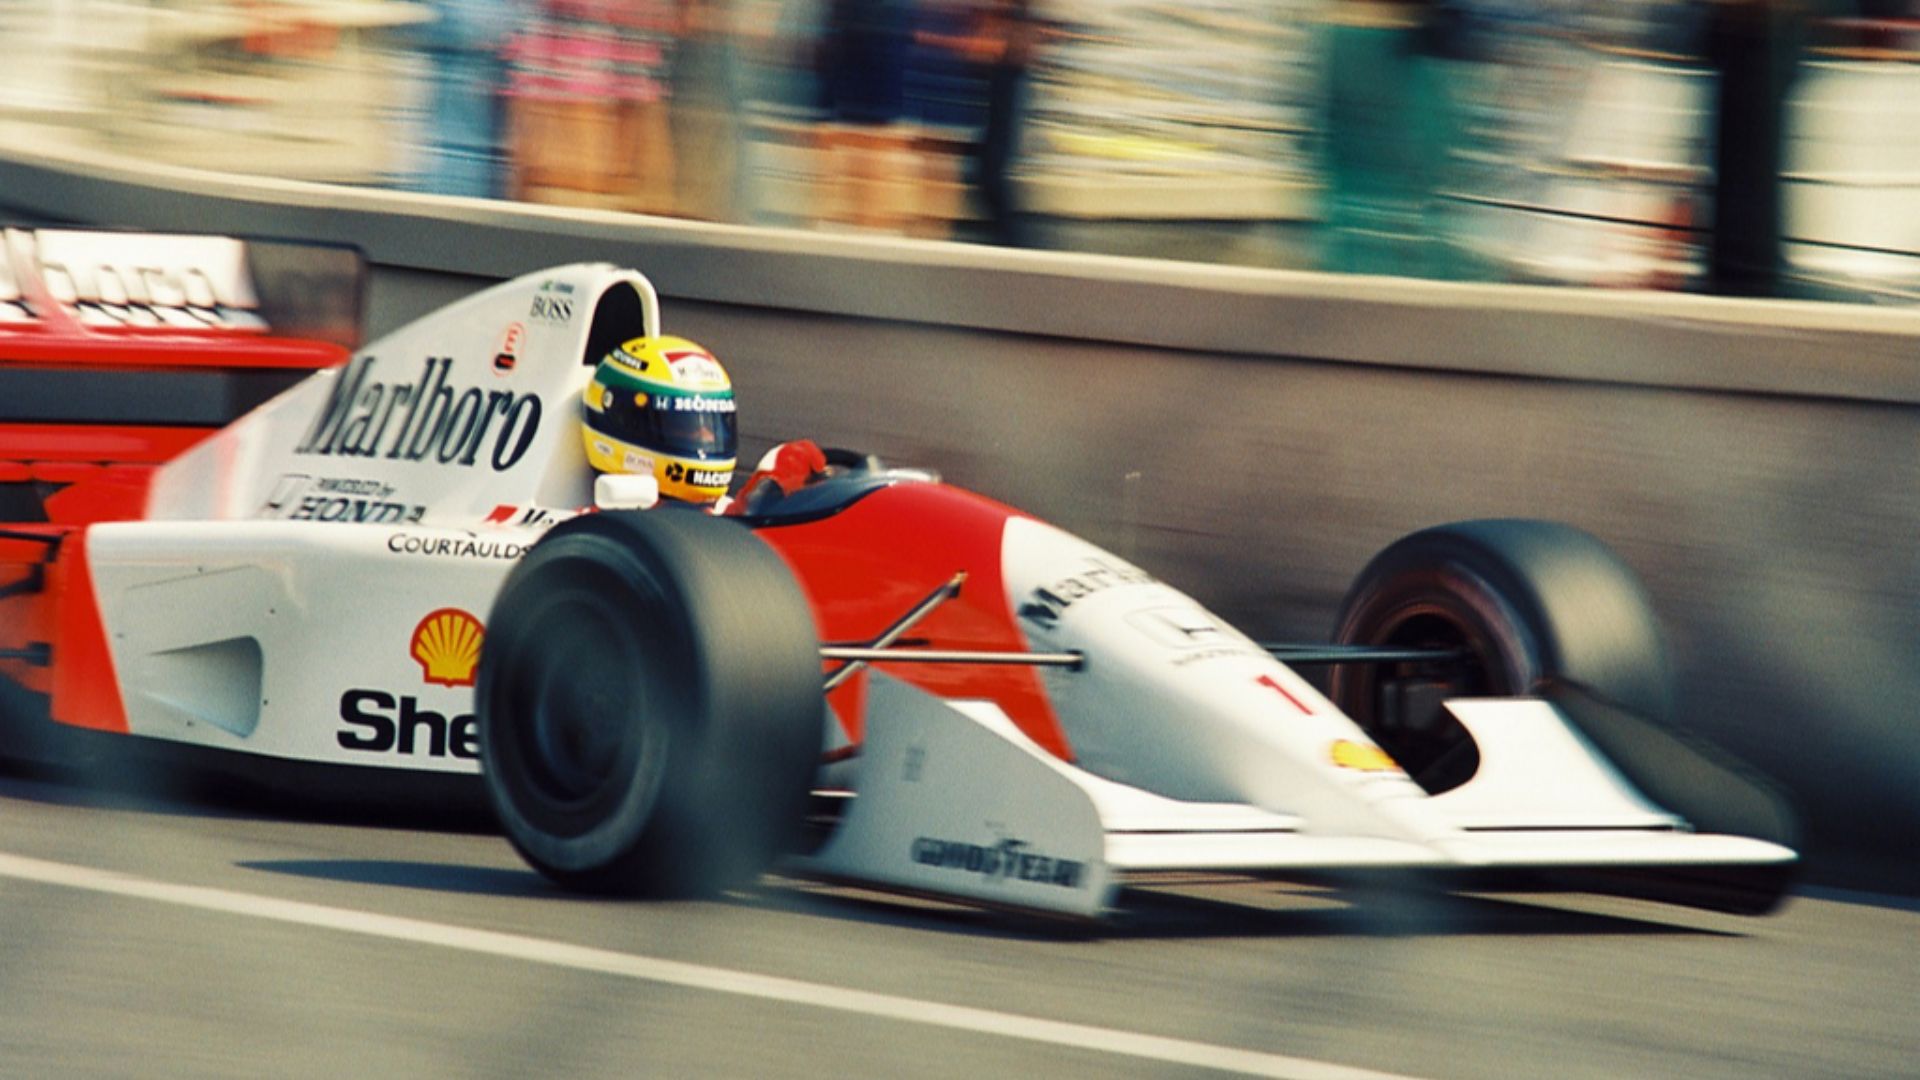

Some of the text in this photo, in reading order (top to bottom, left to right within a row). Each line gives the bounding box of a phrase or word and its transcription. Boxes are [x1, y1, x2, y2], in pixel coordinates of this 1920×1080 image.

[530, 296, 573, 321] BOSS
[294, 356, 542, 471] Marlboro
[674, 394, 736, 412] HONDA
[288, 496, 426, 523] HONDA
[1255, 673, 1316, 716] 1
